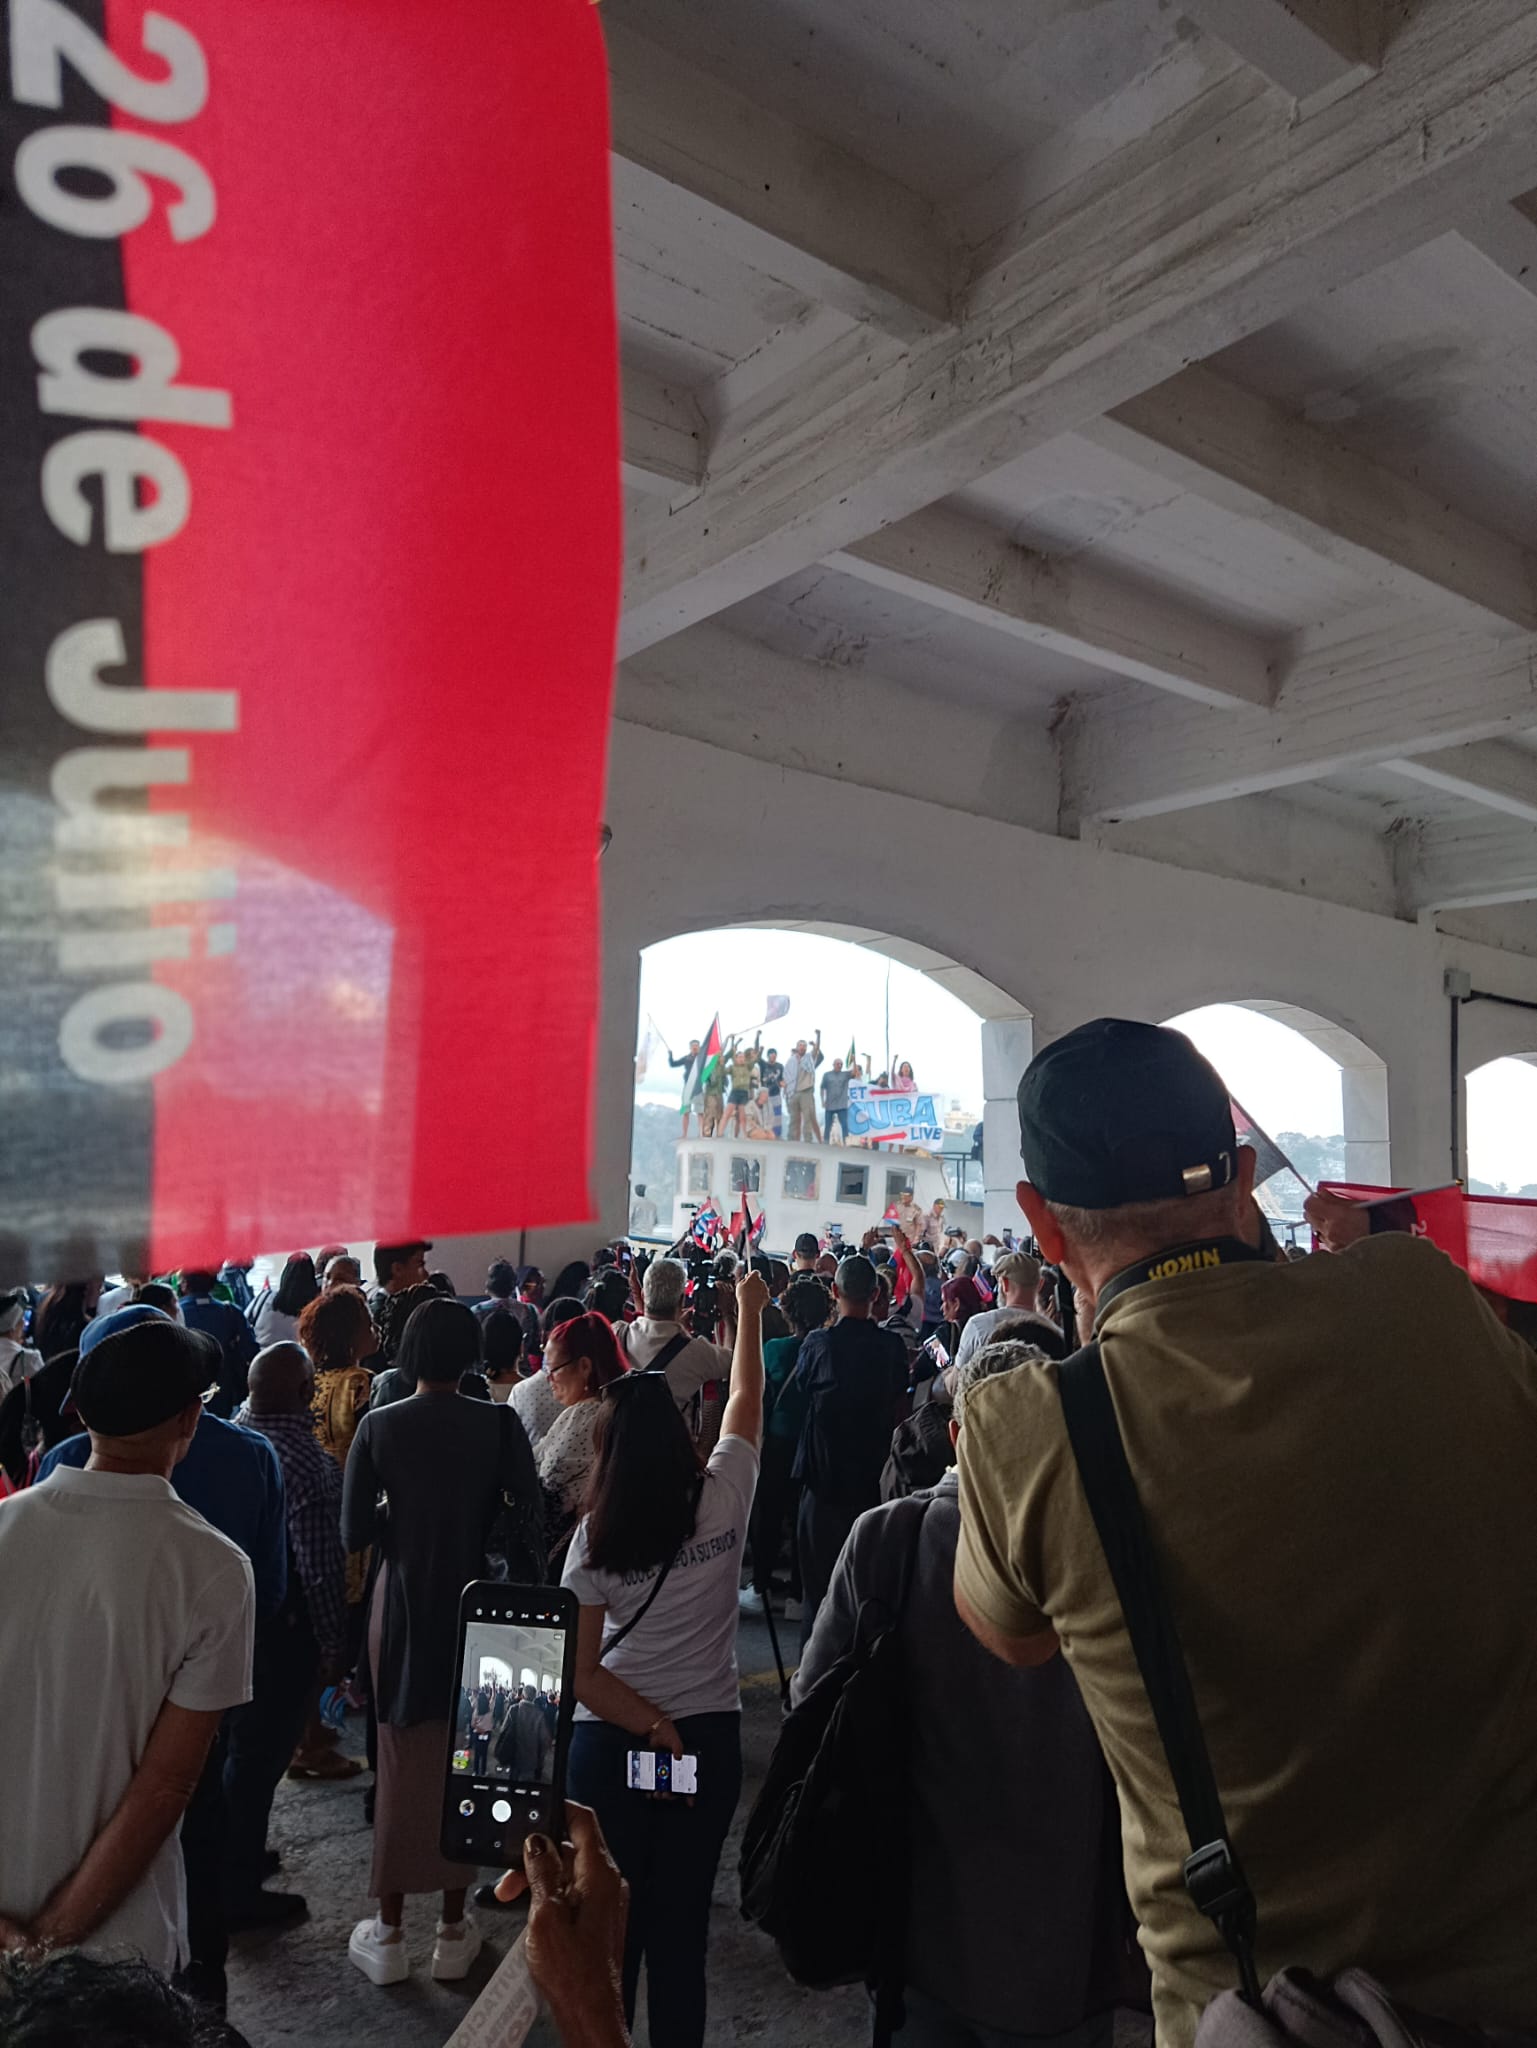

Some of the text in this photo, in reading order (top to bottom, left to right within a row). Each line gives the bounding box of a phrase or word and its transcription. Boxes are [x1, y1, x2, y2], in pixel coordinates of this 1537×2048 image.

[9, 0, 239, 1086] 26 de Julio
[848, 1086, 867, 1099] ET
[847, 1096, 937, 1135] CUBA
[911, 1127, 942, 1140] LIVE
[710, 1528, 737, 1559] FAVOR
